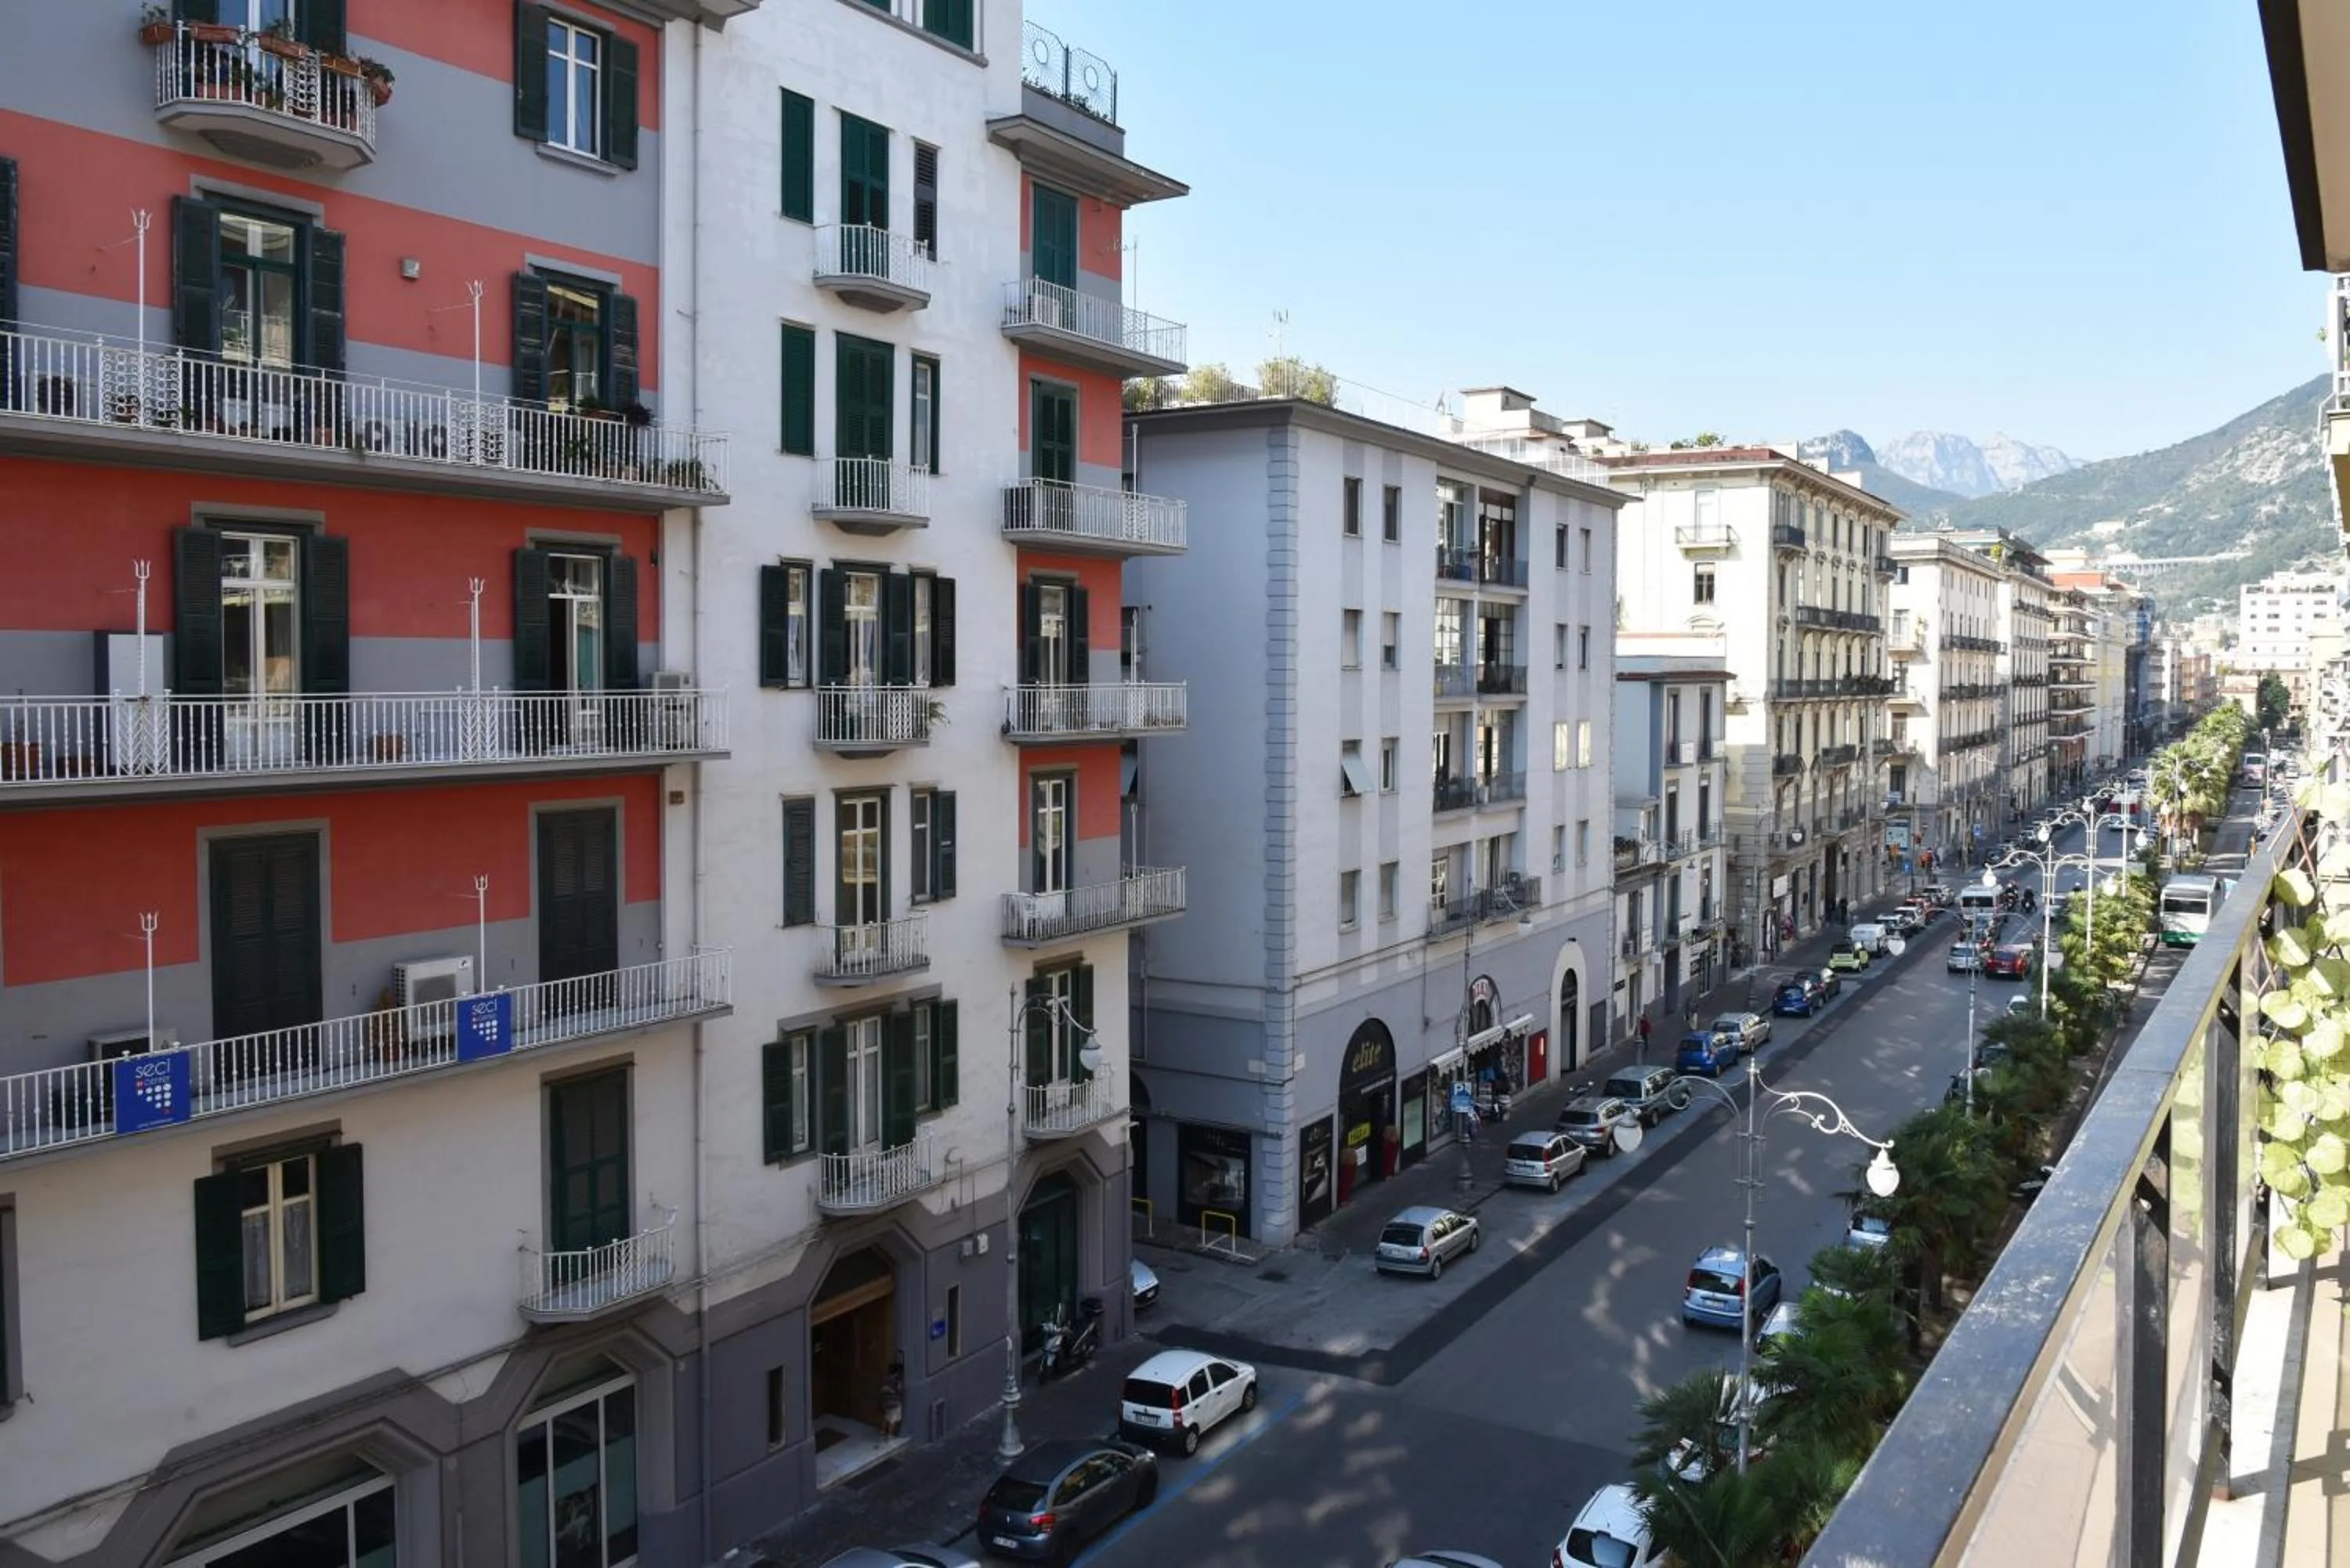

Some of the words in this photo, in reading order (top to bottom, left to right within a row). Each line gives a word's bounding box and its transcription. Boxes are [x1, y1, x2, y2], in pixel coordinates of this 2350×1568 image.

[1352, 1041, 1381, 1072] elite
[135, 1057, 170, 1078] seci
[1454, 1083, 1464, 1096] P
